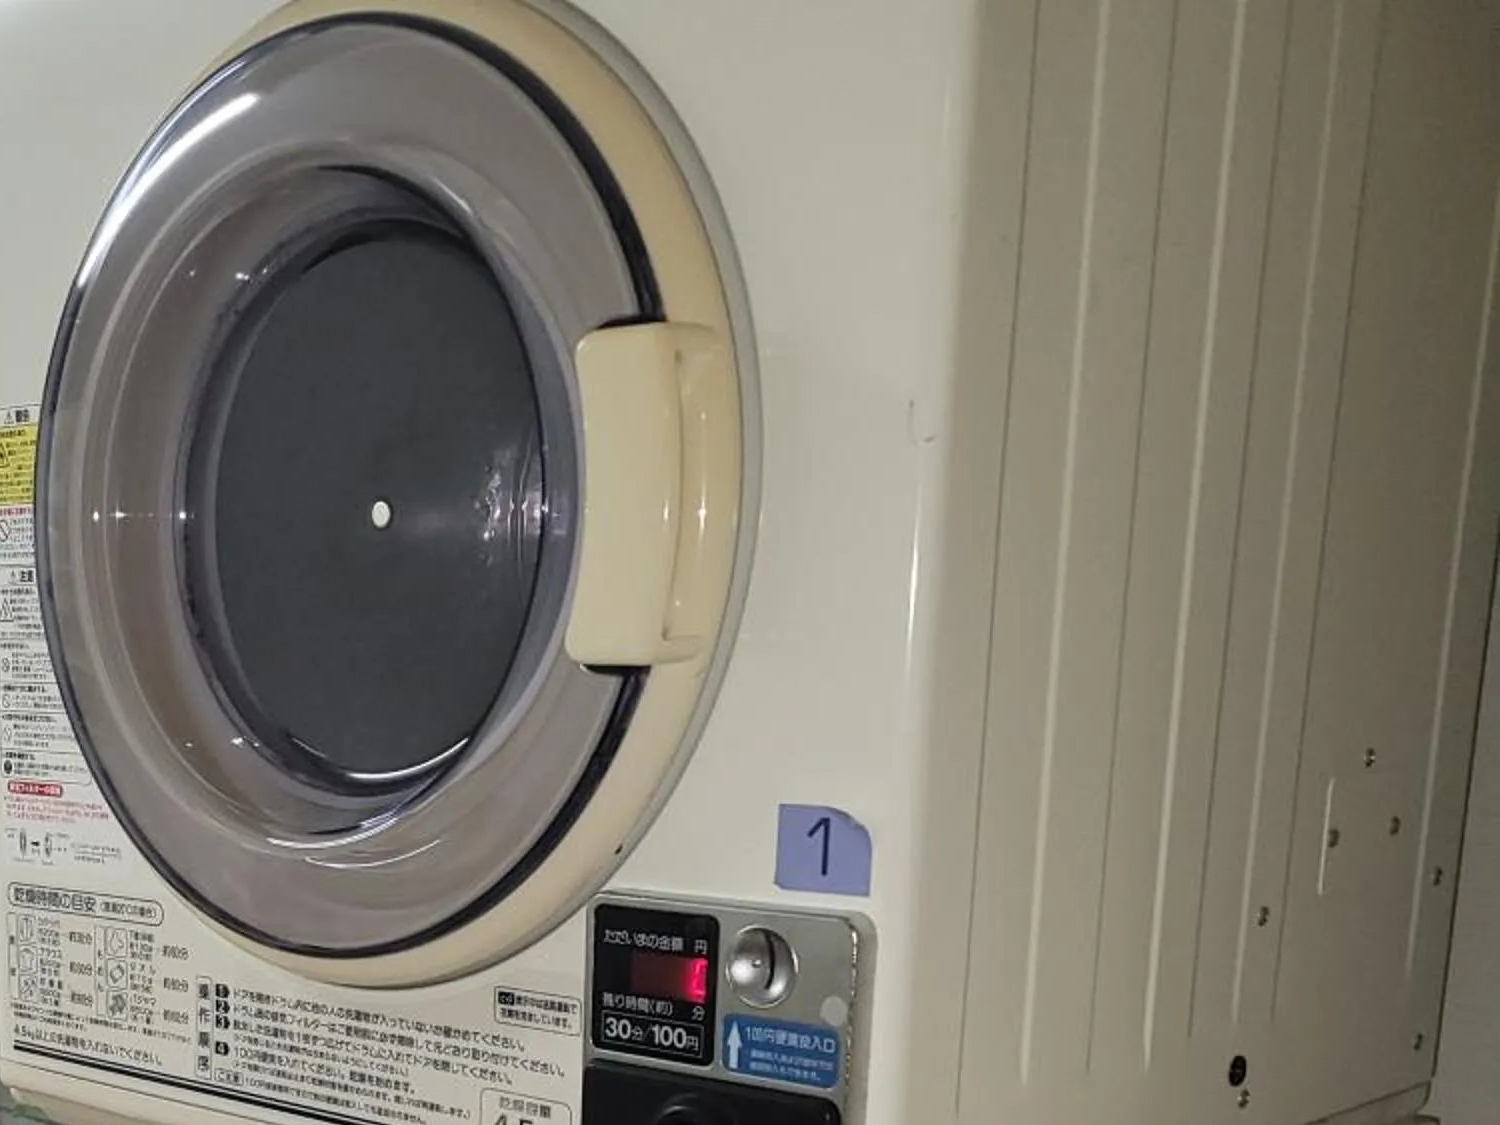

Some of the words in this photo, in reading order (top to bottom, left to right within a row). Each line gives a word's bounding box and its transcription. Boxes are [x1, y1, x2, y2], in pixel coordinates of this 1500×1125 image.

[806, 816, 832, 877] 1
[603, 929, 684, 951] ただいまの金額
[694, 939, 708, 954] 円
[692, 1006, 705, 1021] 分
[604, 1017, 700, 1051] 30分/100円
